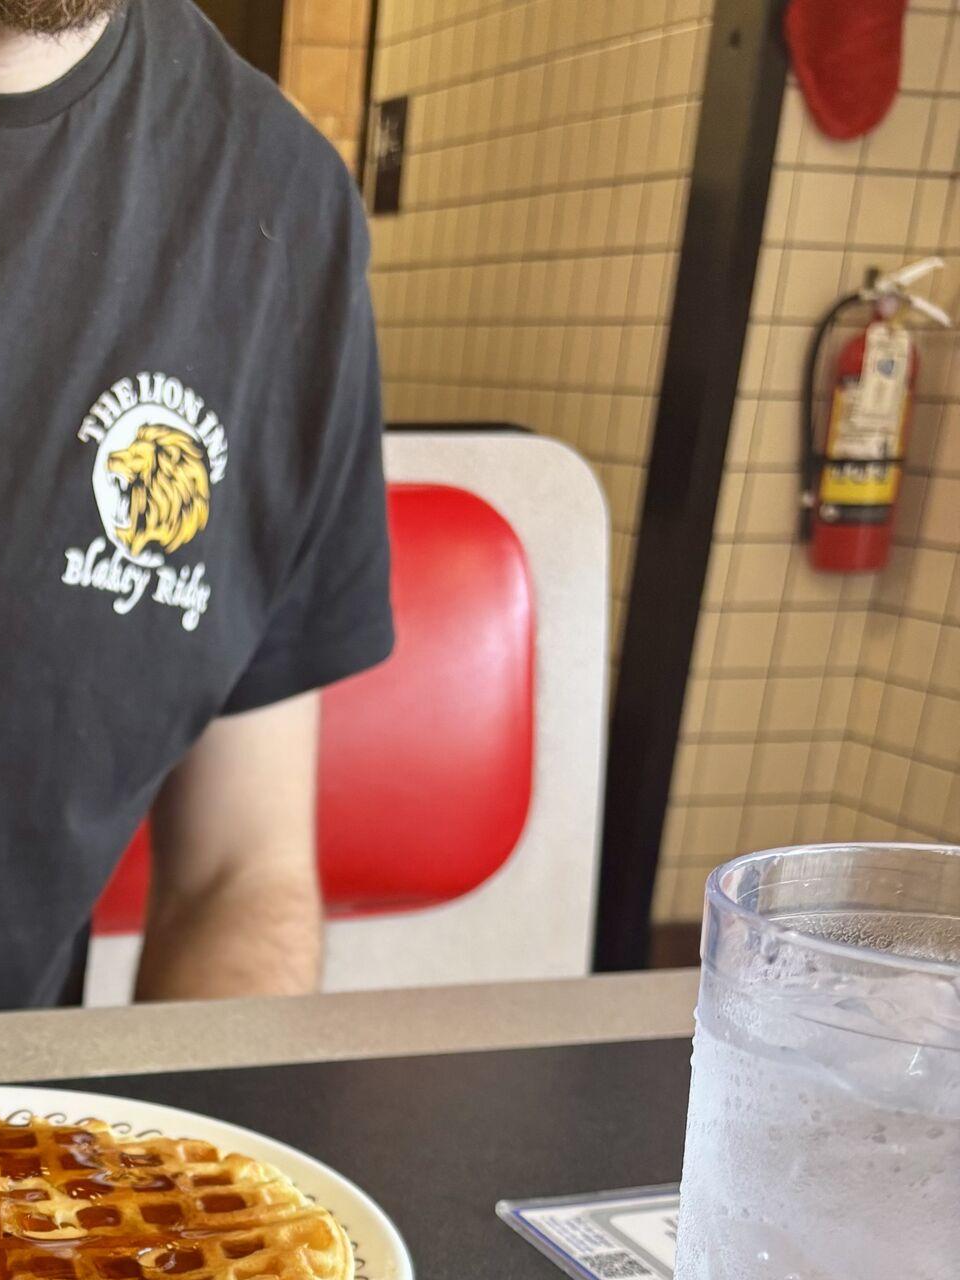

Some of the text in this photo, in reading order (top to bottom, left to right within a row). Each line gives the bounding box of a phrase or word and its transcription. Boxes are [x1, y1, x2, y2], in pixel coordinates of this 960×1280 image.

[78, 377, 138, 445] THE
[136, 371, 205, 424] LION
[61, 536, 151, 615] Blakey
